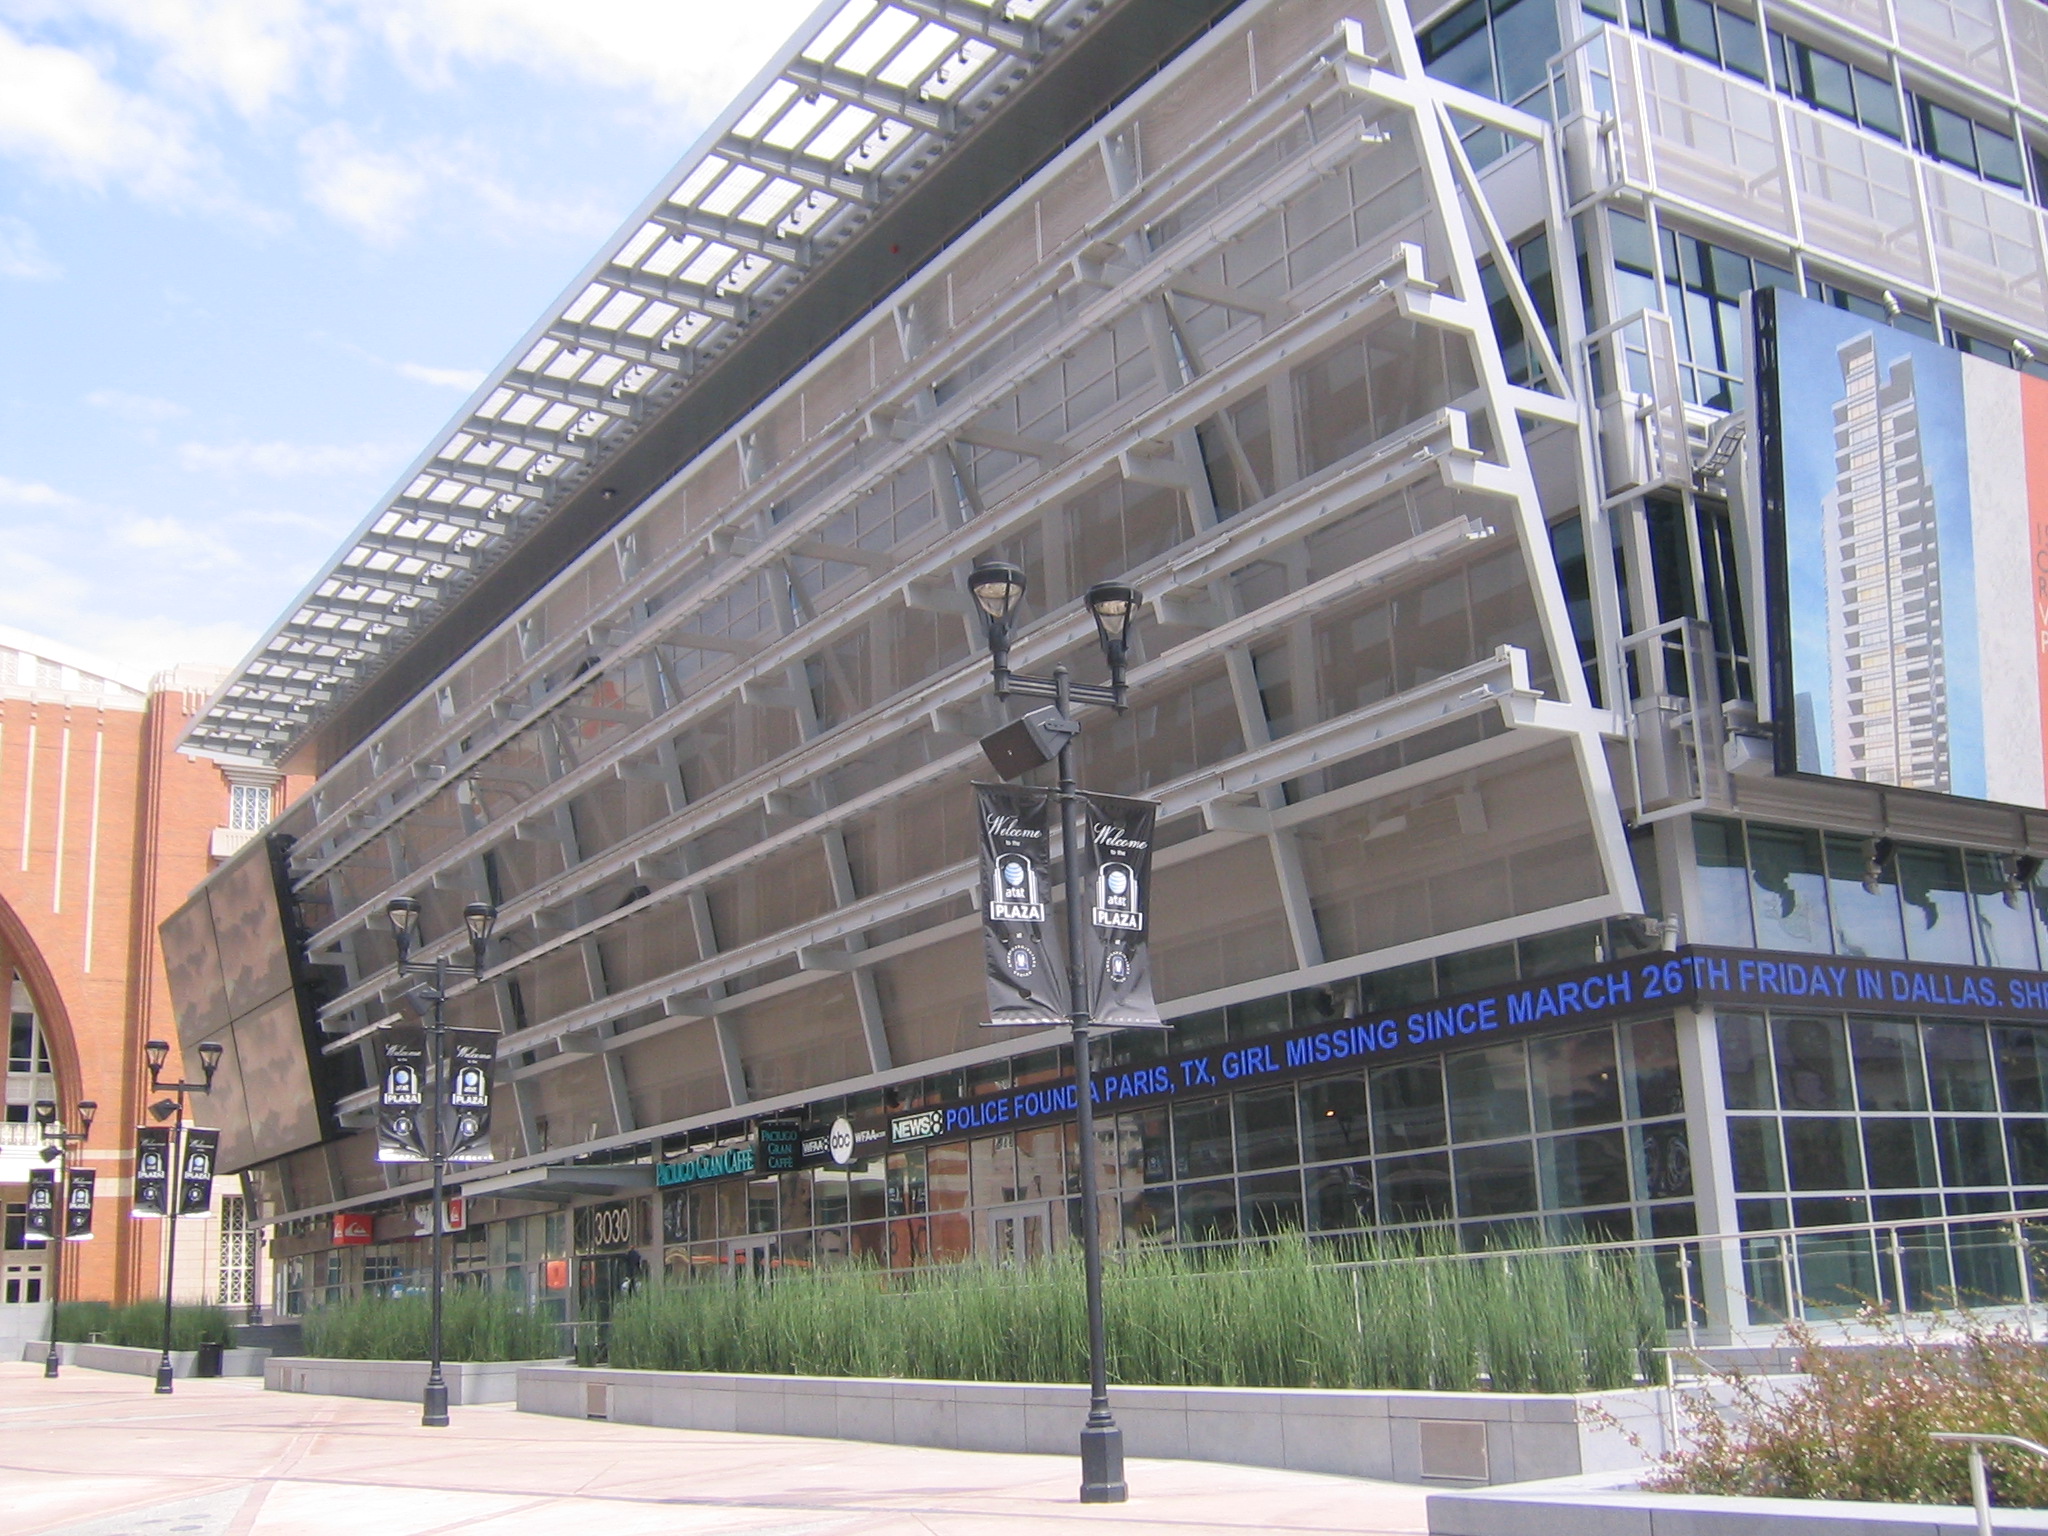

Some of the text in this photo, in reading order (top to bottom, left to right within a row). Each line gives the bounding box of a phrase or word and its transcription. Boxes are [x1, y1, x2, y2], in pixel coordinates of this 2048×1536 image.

[987, 813, 1042, 839] Welcome
[1094, 822, 1148, 850] Welcome
[995, 904, 1041, 920] PLAZA
[1098, 911, 1138, 928] PLAZA
[947, 1099, 1010, 1131] POLICE
[1015, 1085, 1078, 1119] FOUND
[1106, 1066, 1176, 1102] PARIS,
[1181, 1057, 1217, 1090] TX,
[1222, 1046, 1281, 1081] GIRL
[1287, 1020, 1400, 1067] MISSING
[1408, 999, 1500, 1045] SINCE
[1508, 971, 1633, 1026] MARCH
[1642, 956, 1732, 1000] 26TH
[1738, 959, 1848, 998] FRIDAY
[1855, 970, 1886, 1001] IN
[1891, 971, 2004, 1009] DALLAS.
[388, 1094, 418, 1104] PLAZA
[456, 1096, 484, 1105] PLAZA
[831, 1131, 851, 1149] abc
[595, 1208, 630, 1246] 3030
